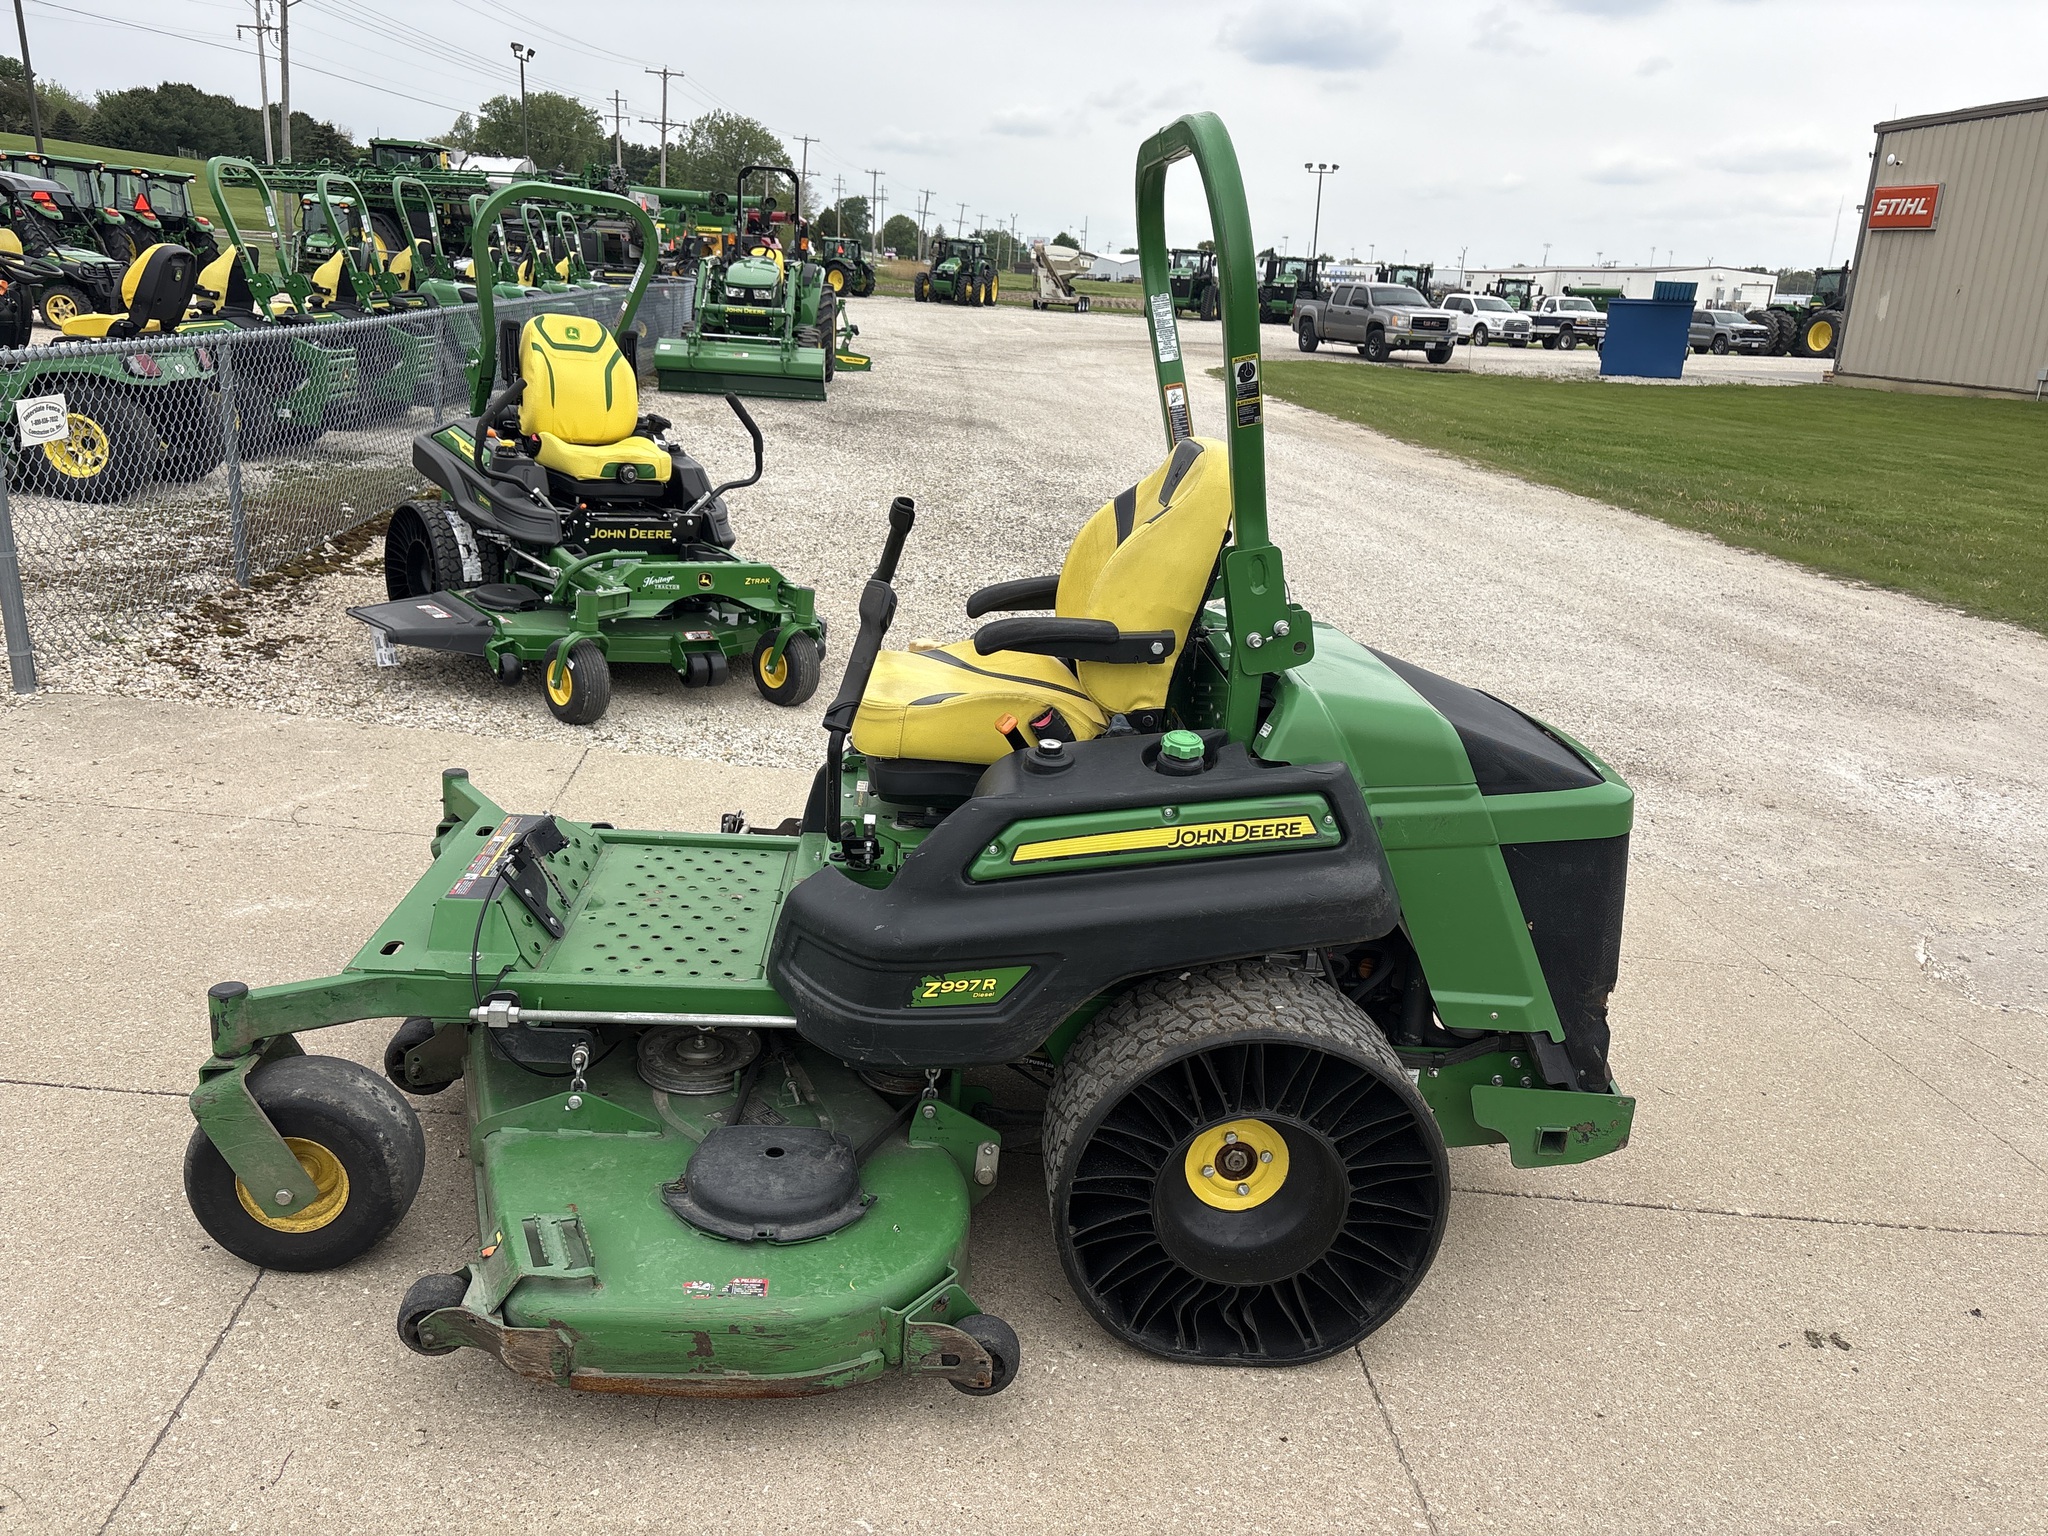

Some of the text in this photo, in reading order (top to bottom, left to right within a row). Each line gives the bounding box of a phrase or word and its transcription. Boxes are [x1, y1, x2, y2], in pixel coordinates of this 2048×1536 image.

[1873, 197, 1928, 216] STIHL
[744, 307, 766, 315] DEERE
[46, 404, 60, 413] Fence
[590, 527, 672, 539] JOHN DEERE
[642, 575, 675, 588] Heritage
[745, 577, 771, 585] ZTRAK
[1167, 822, 1302, 846] JOHN DEERE
